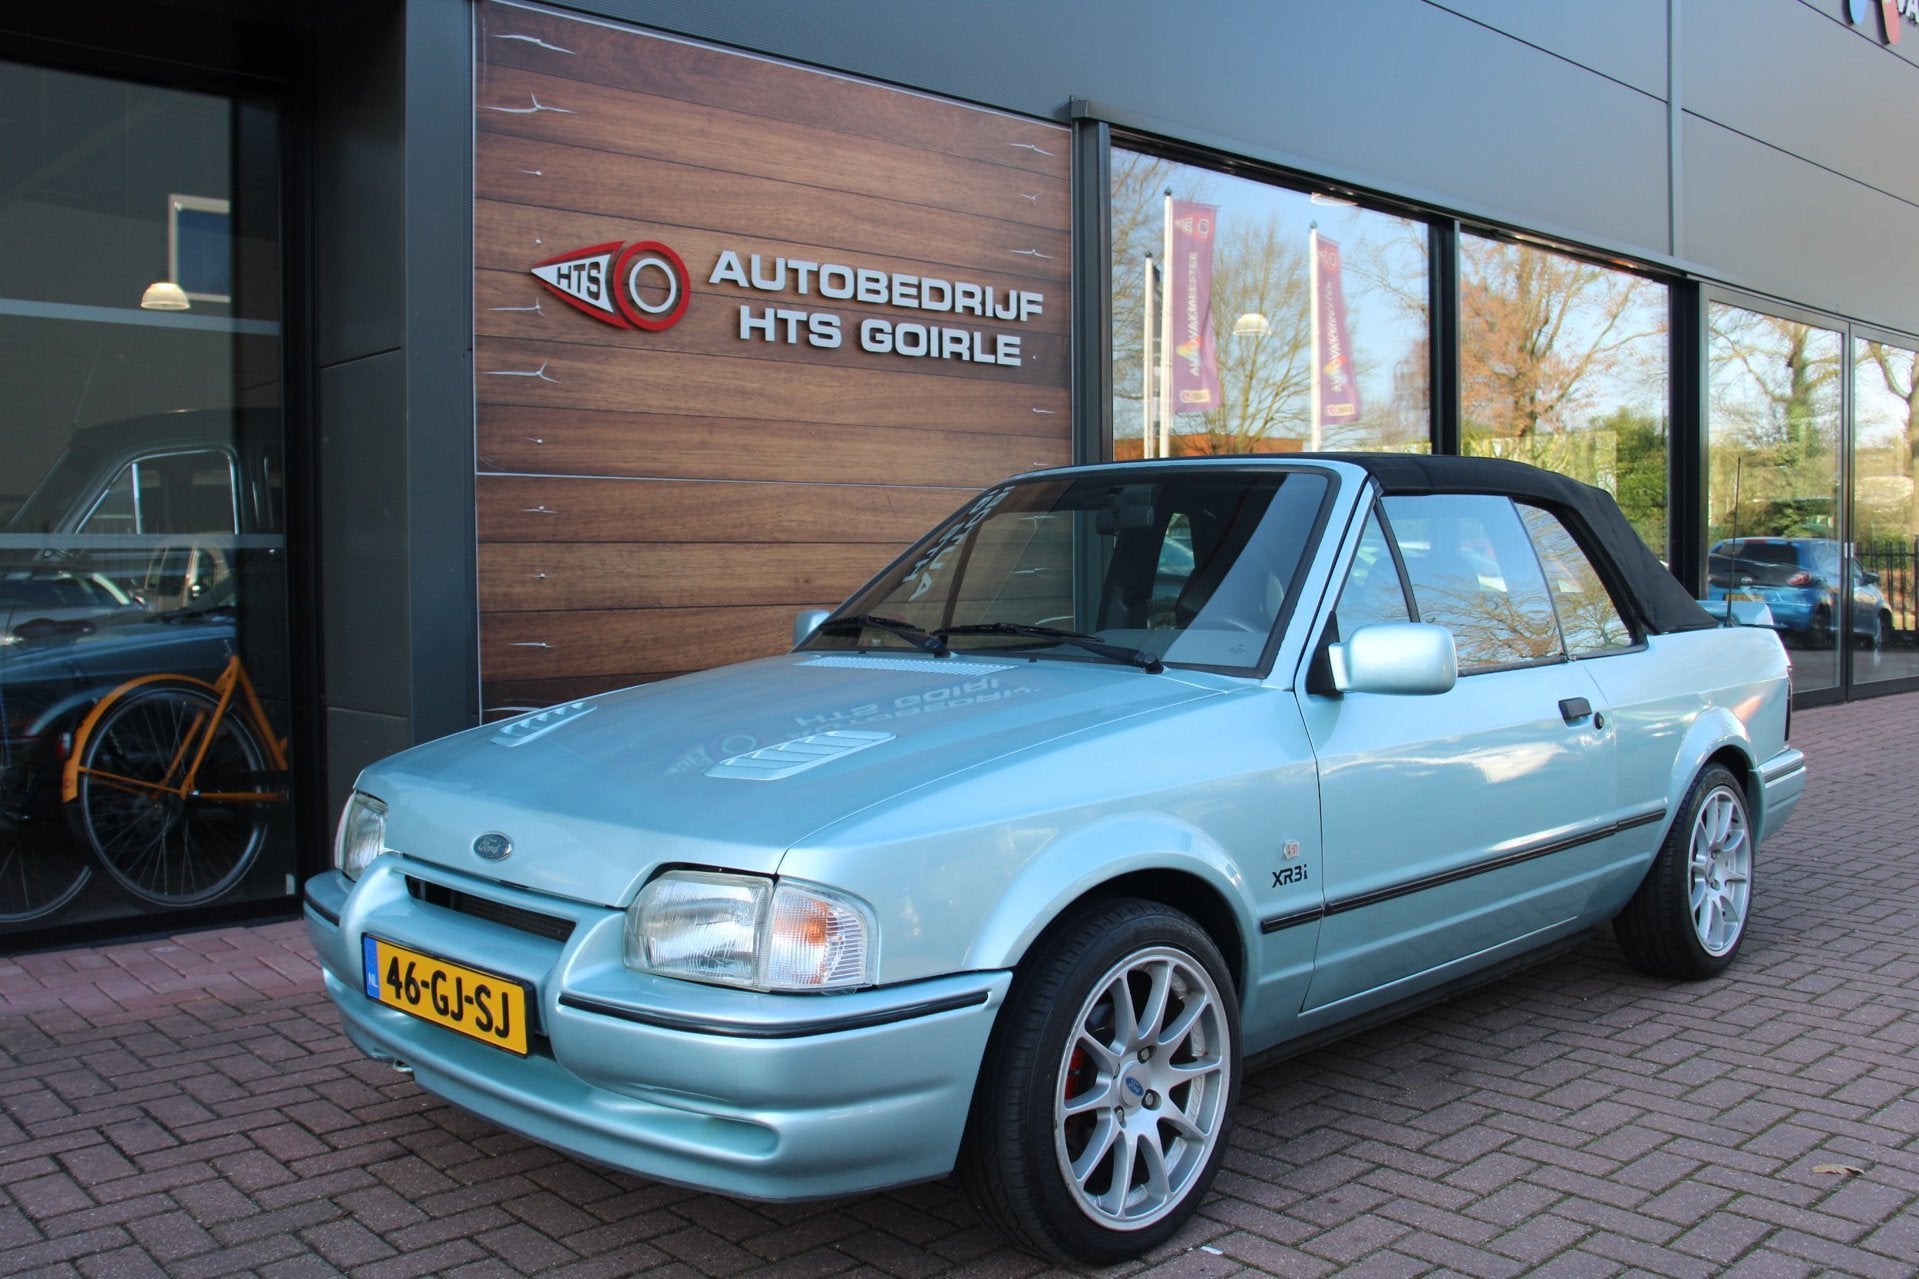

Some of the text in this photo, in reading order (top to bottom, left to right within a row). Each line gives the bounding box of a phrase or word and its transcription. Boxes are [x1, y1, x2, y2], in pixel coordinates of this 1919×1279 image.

[556, 261, 601, 301] HTS
[709, 248, 1044, 322] AUTOBEDRIJF
[739, 304, 1022, 367] HTS GOIRLE
[1272, 864, 1308, 888] XR3i
[368, 972, 379, 988] NL
[386, 955, 510, 1039] 46-GJ-SJ
